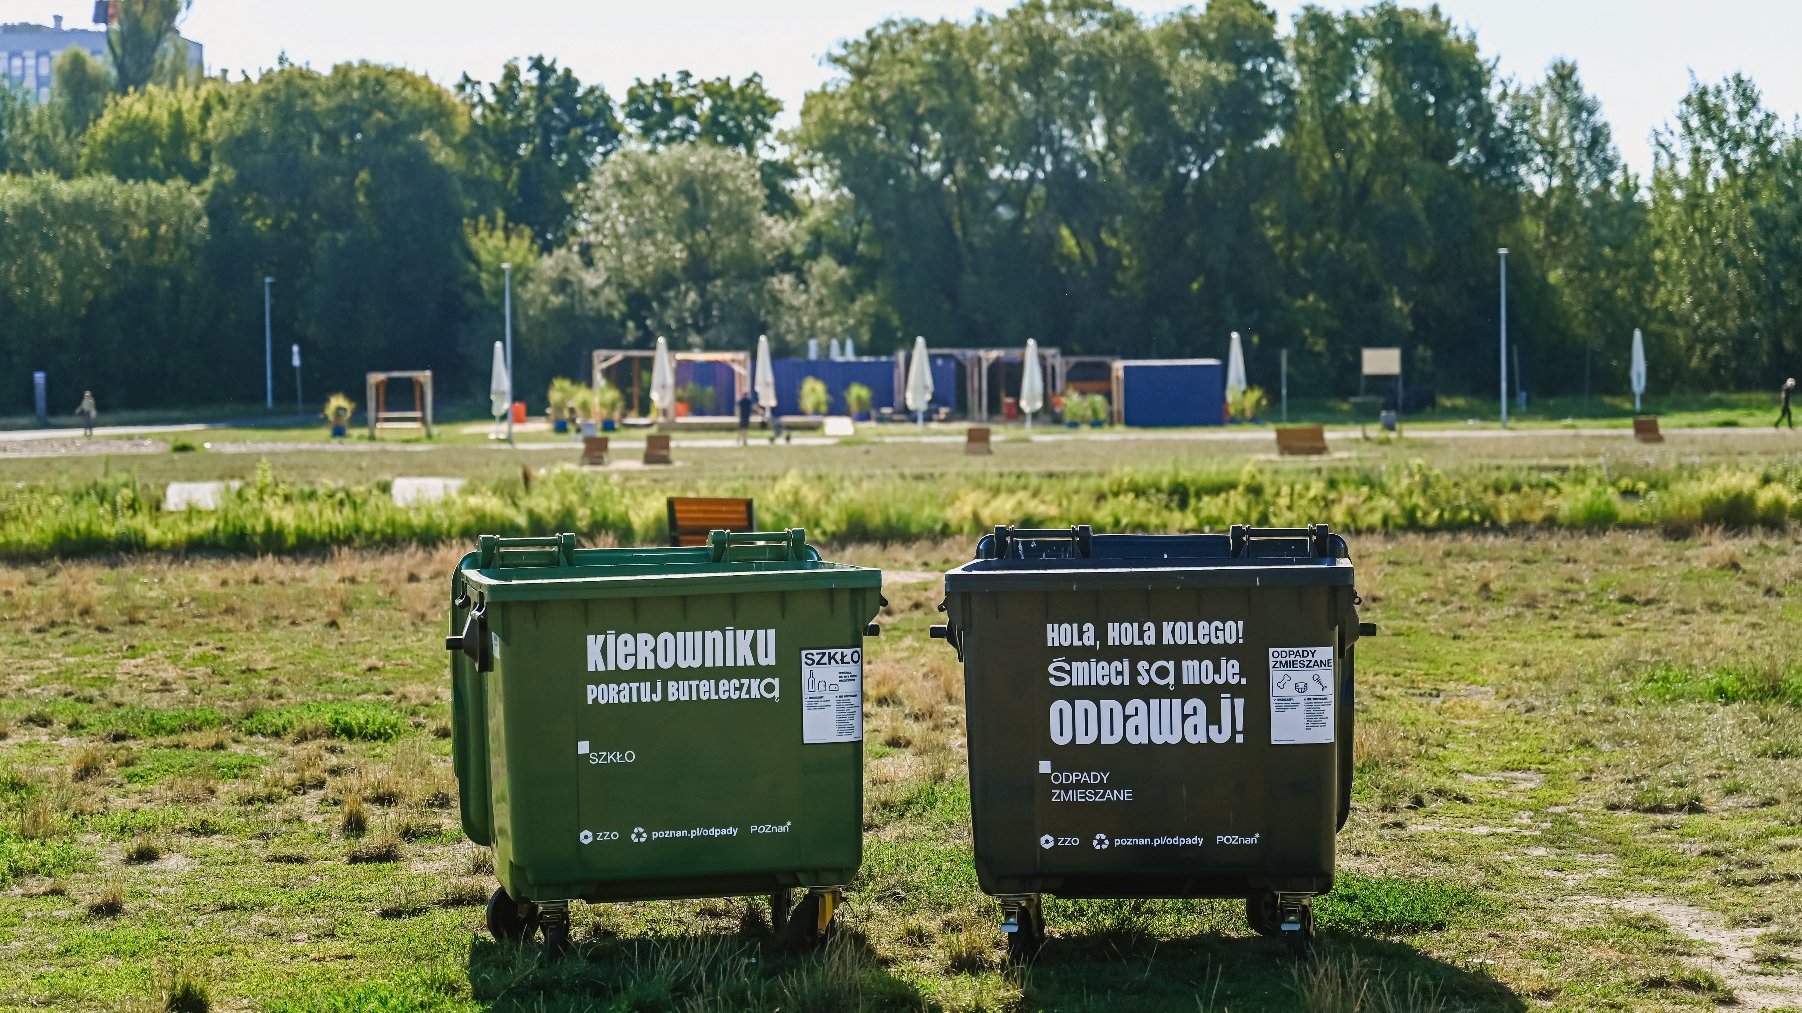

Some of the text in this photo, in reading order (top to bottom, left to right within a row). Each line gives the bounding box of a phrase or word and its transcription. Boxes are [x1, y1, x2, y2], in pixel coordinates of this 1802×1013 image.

[803, 649, 861, 666] SZKŁO
[1271, 649, 1317, 659] ODPADY
[1271, 658, 1333, 669] ZMIESZANE
[1136, 661, 1175, 690] są
[590, 750, 636, 764] SZKŁO
[1050, 772, 1110, 785] ODPADY
[1052, 789, 1133, 802] ZMIESZANE
[596, 831, 620, 841] ZZO
[651, 826, 739, 841] poznan.pl/odpady
[1057, 837, 1080, 846] ZZO
[1114, 835, 1204, 848] poznan.pl/odpady
